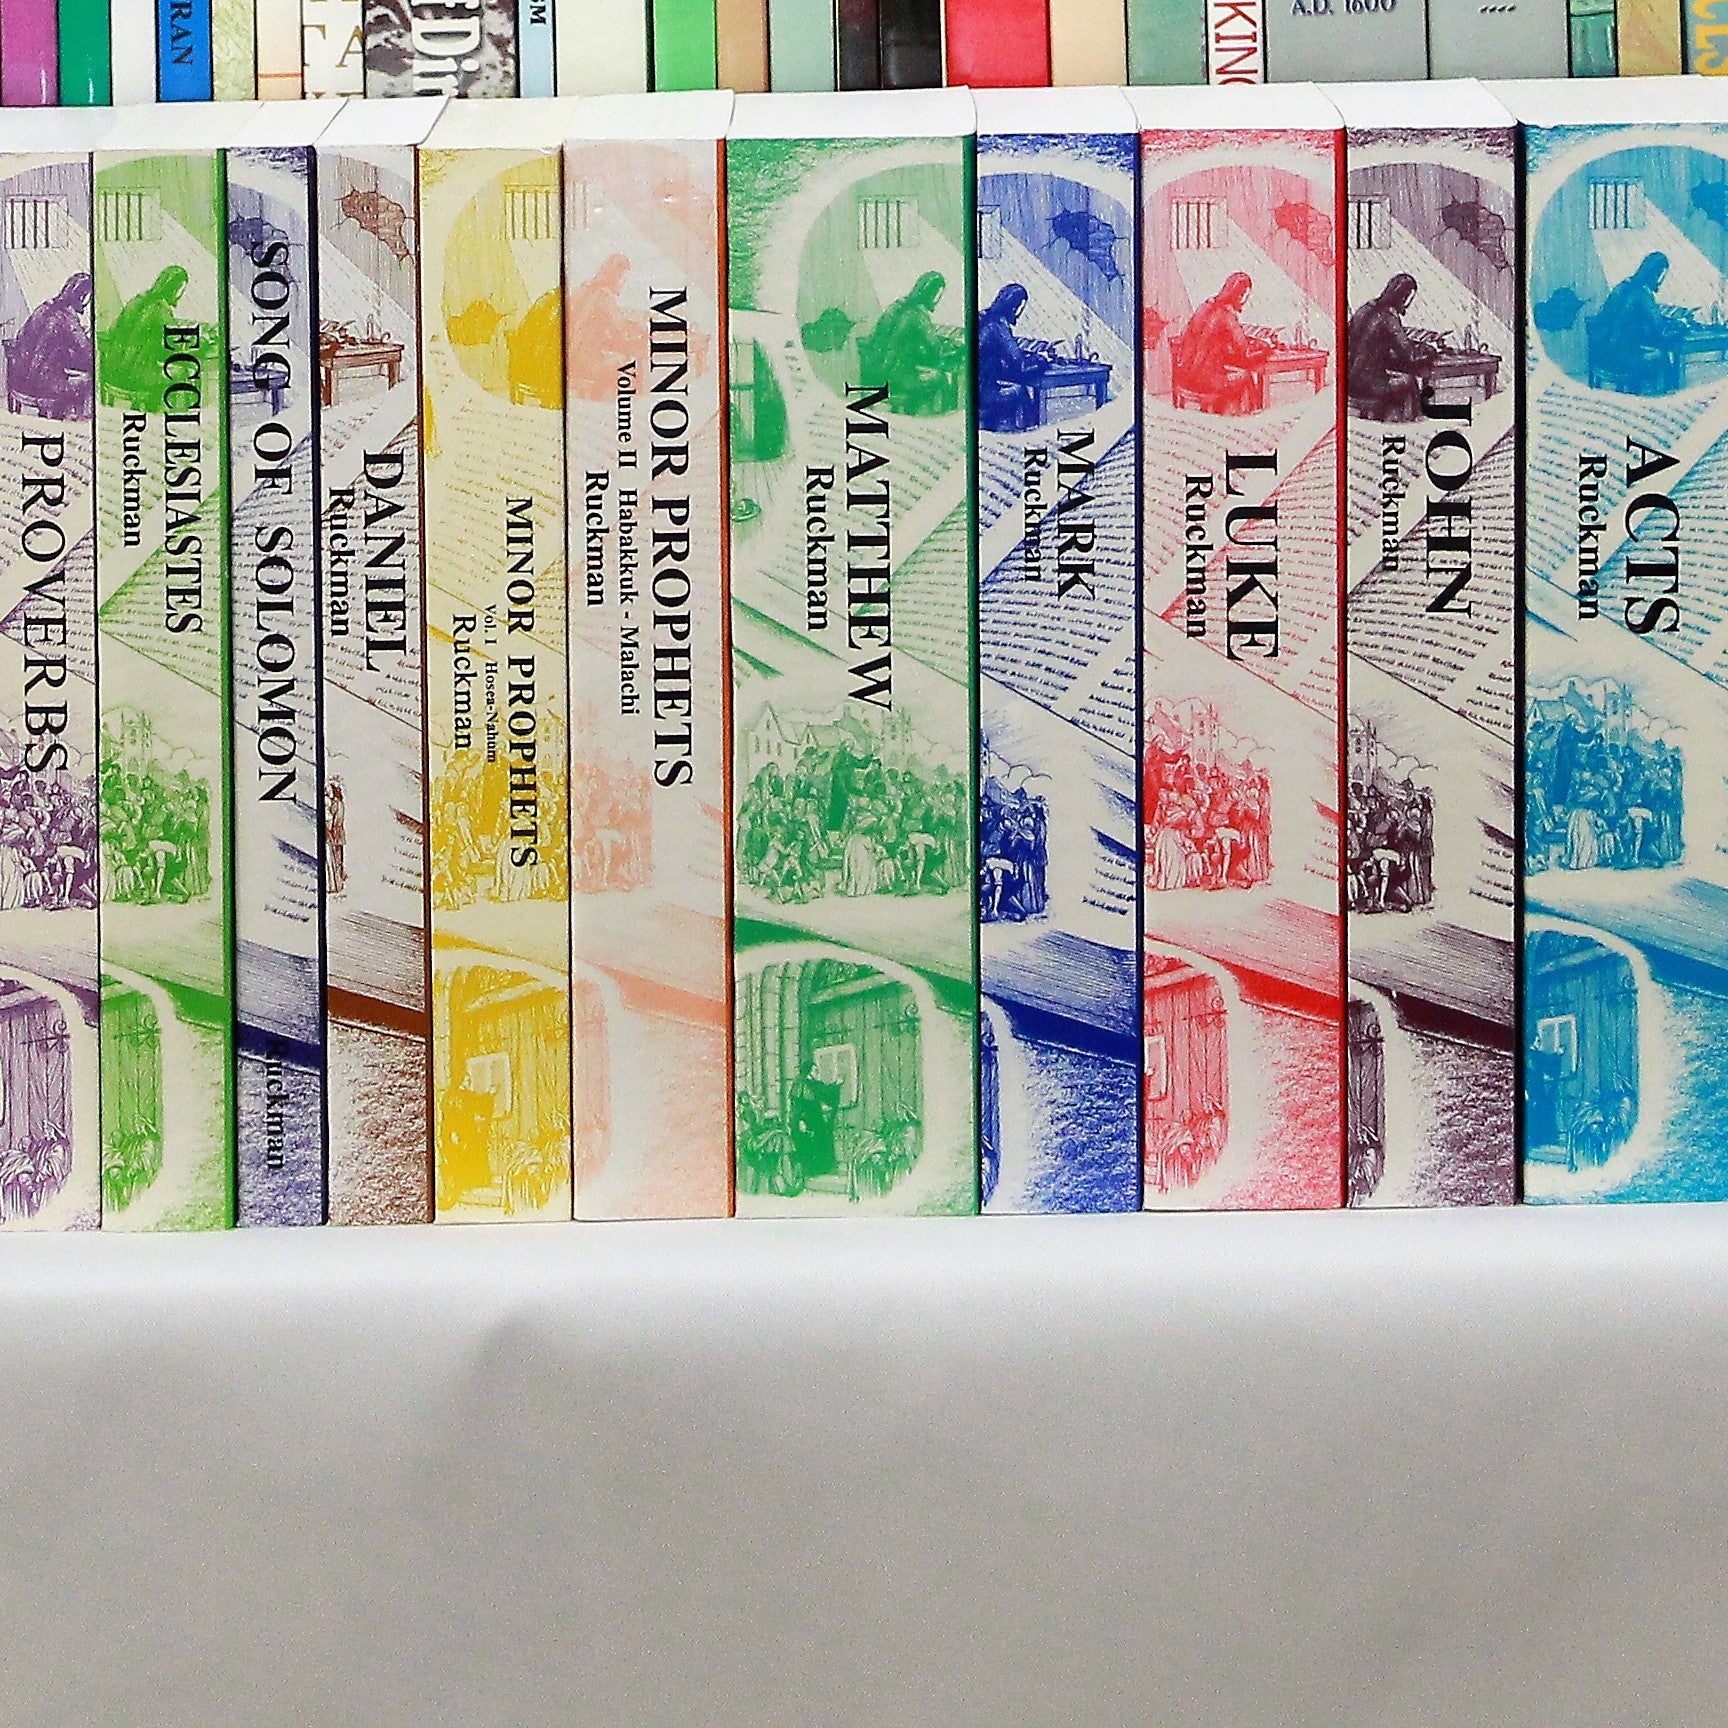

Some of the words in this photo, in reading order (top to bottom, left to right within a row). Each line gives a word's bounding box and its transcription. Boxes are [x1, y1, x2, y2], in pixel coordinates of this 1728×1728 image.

[250, 242, 290, 390] SONG
[617, 360, 636, 443] Volume
[650, 286, 688, 481] MINOR
[162, 324, 203, 635] ECCLESIASTES
[253, 423, 292, 496] OF
[585, 471, 609, 607] Ruckman
[619, 451, 637, 469] II
[1055, 428, 1096, 600] MARK
[1422, 386, 1473, 617] JOHN
[1577, 453, 1605, 621] Ruckman
[1625, 437, 1681, 635] ACTS
[20, 431, 69, 773] PROVERBS
[363, 449, 406, 672] DANIEL
[505, 497, 534, 635] MINOR
[618, 488, 639, 606] Habakkuk
[805, 464, 836, 633] Ruckman
[844, 383, 892, 711] MATTHEW
[1183, 473, 1213, 639] Ruckman
[1224, 449, 1278, 661] LUKE
[253, 527, 296, 804] SOLOMON
[620, 626, 641, 716] Malachi
[651, 495, 695, 789] PROPHETS
[506, 656, 538, 868] PROPHETS
